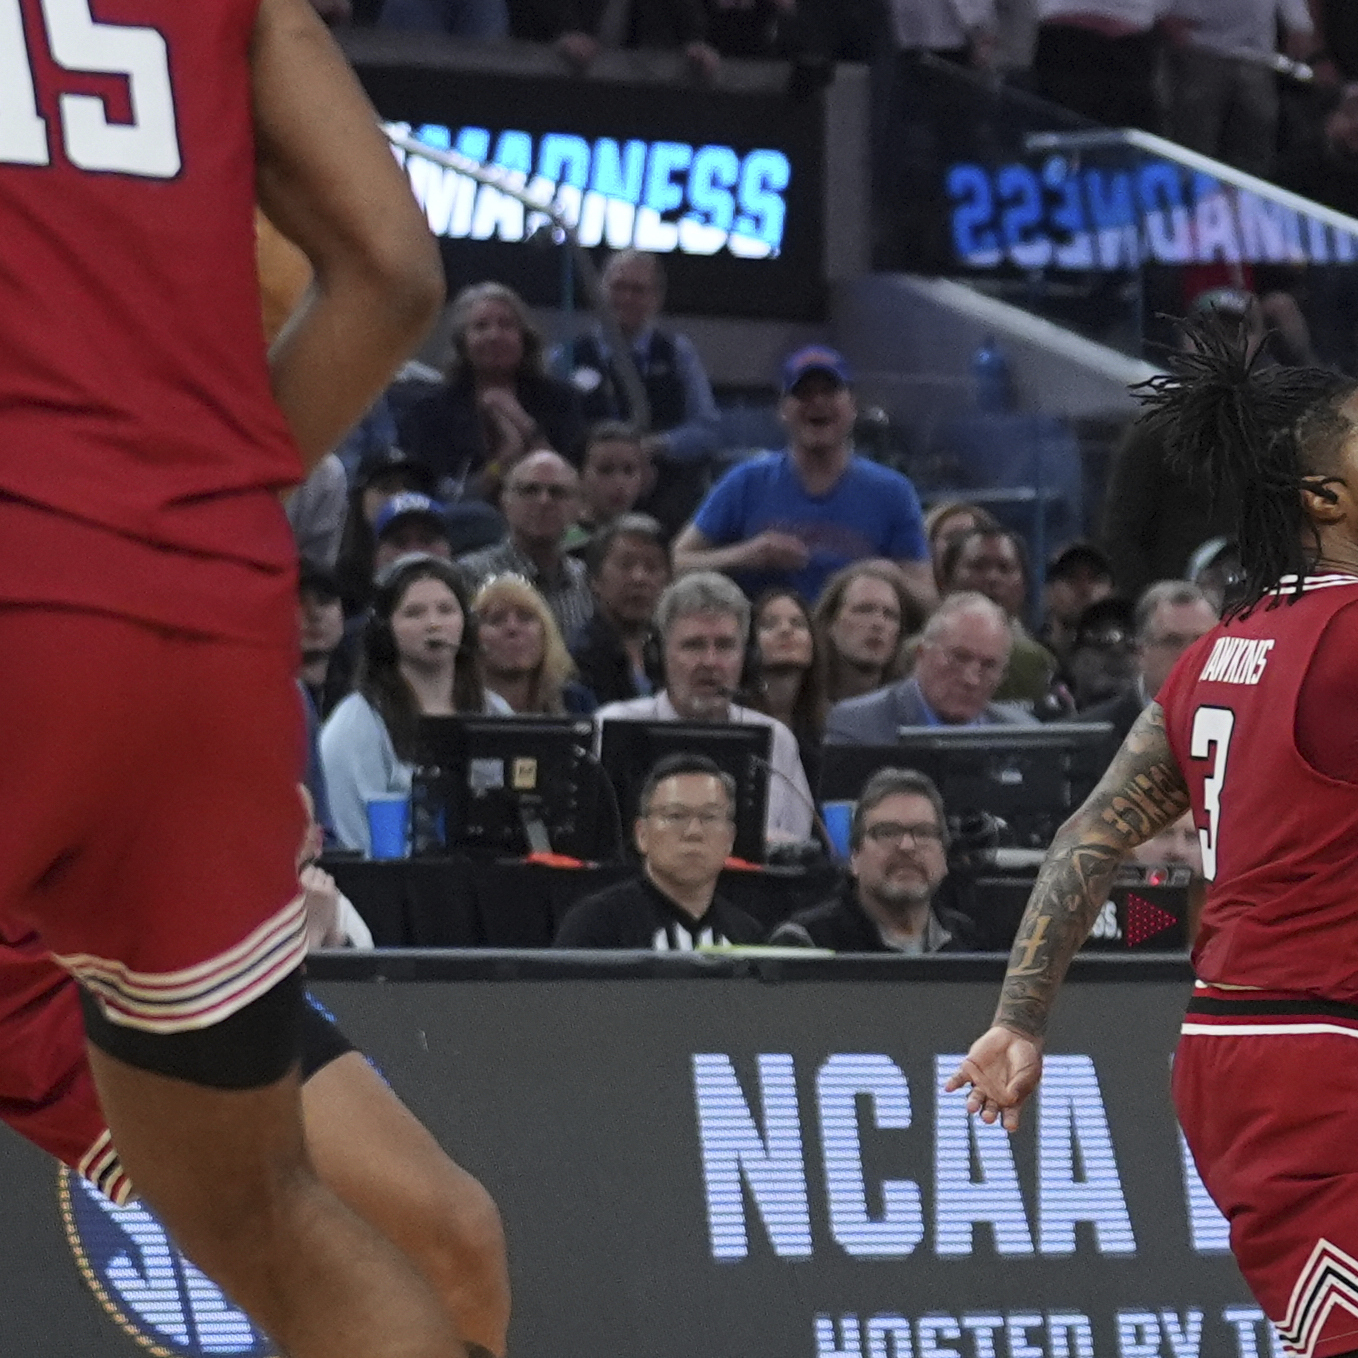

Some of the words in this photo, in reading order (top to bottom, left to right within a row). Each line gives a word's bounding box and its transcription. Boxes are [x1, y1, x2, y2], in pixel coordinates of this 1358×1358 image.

[408, 123, 791, 260] MADNESS
[1189, 704, 1236, 882] 3
[692, 1051, 1138, 1260] NCAA
